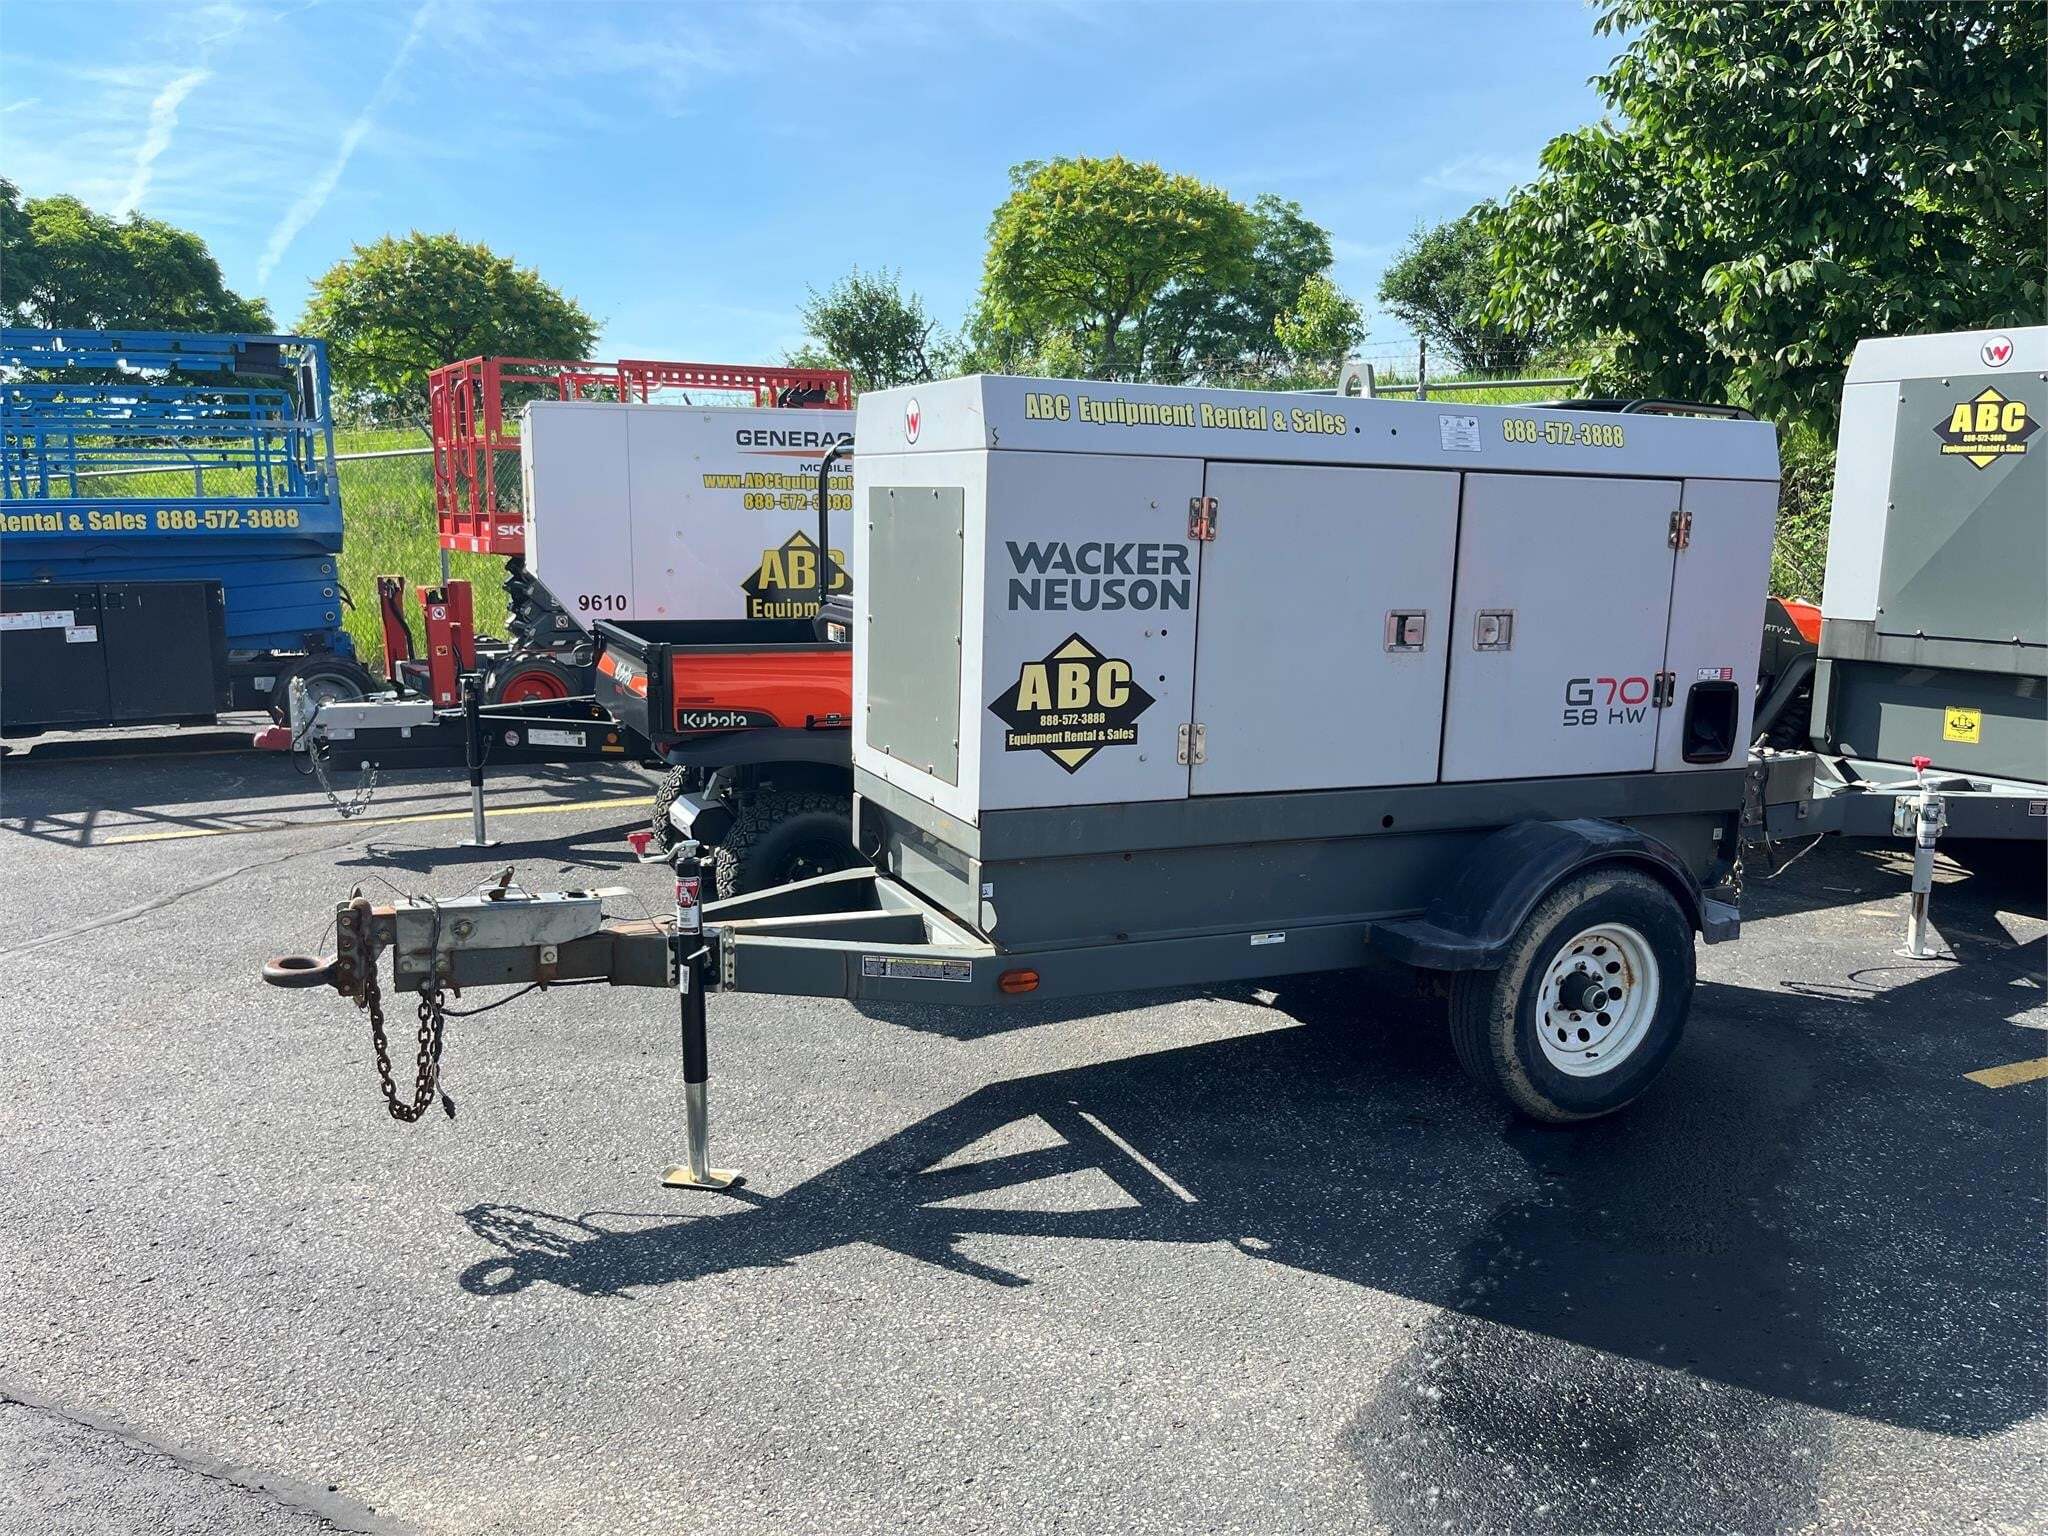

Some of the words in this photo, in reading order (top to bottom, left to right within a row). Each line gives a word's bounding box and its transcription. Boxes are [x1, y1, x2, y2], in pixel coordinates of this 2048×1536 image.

[1025, 392, 1070, 421] ABC
[1077, 396, 1196, 427] Equipment
[1200, 402, 1267, 430] Rental
[1272, 410, 1289, 432] &
[1291, 408, 1346, 435] Sales
[1949, 402, 2027, 433] ABC
[1502, 419, 1624, 448] 888-572-3888
[69, 513, 84, 531] &
[88, 511, 147, 531] Sales
[156, 509, 300, 530] 888-572-3888
[758, 549, 845, 589] ABC
[1005, 541, 1191, 575] WACKER
[578, 595, 627, 611] 9610
[1008, 578, 1191, 611] NEUSON
[1764, 623, 1792, 635] RTV-X
[1016, 660, 1130, 711] ABC
[1565, 676, 1650, 706] G70
[683, 711, 748, 728] Kubota
[1040, 713, 1106, 726] 888-572-3888
[1563, 708, 1598, 726] 58
[1008, 732, 1062, 746] Equipment
[1064, 729, 1096, 743] Rental
[1099, 730, 1105, 741] &
[1107, 728, 1134, 740] Sales
